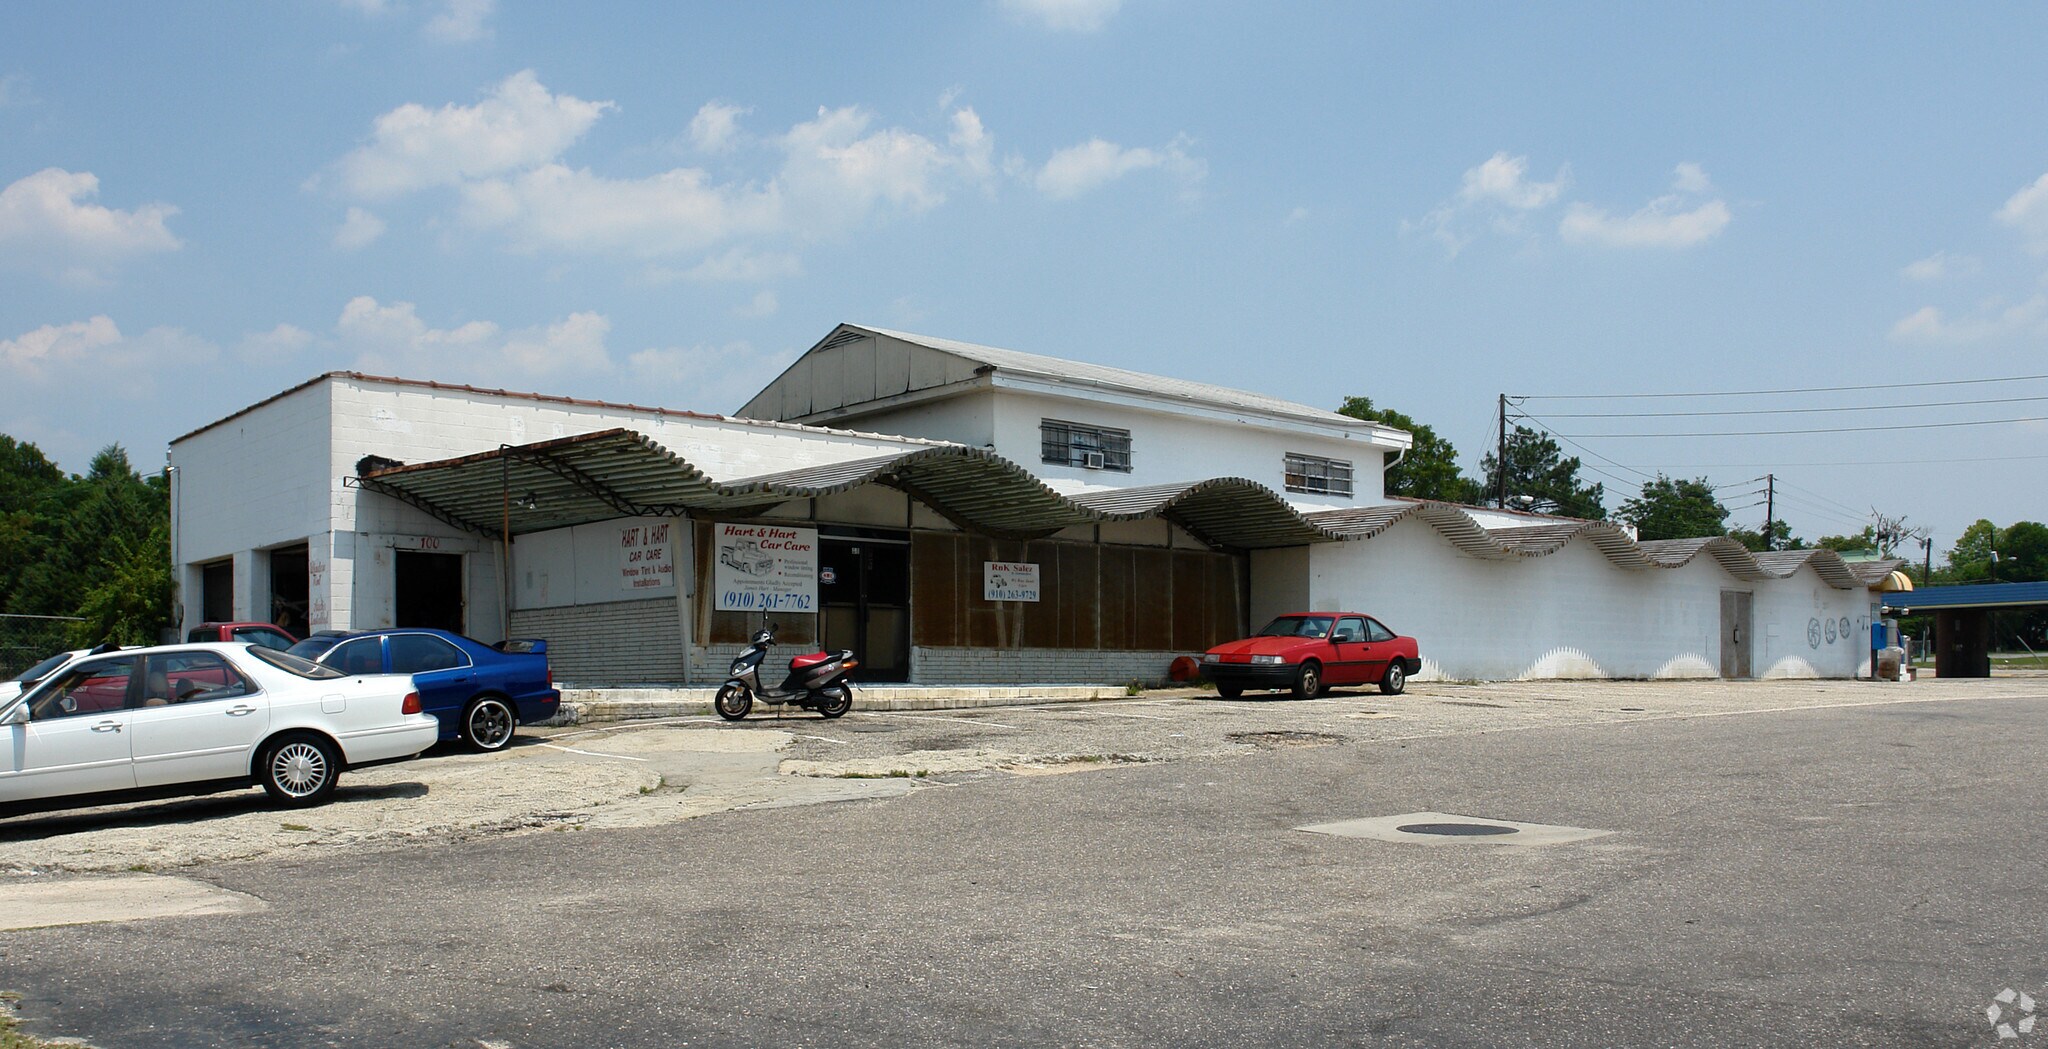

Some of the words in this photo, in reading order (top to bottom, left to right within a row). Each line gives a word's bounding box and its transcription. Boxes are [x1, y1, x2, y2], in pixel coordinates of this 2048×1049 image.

[622, 528, 639, 548] HART
[643, 527, 648, 545] &
[651, 524, 669, 545] HART
[724, 525, 754, 537] Hart
[757, 527, 766, 537] &
[769, 528, 797, 539] Hart
[420, 536, 440, 549] 100
[760, 539, 782, 550] Car
[784, 540, 810, 552] Care
[629, 551, 642, 562] CAR
[646, 548, 662, 561] CARE
[724, 591, 755, 608] (910)
[758, 592, 811, 609] 261-7762
[988, 589, 1006, 599] (910)
